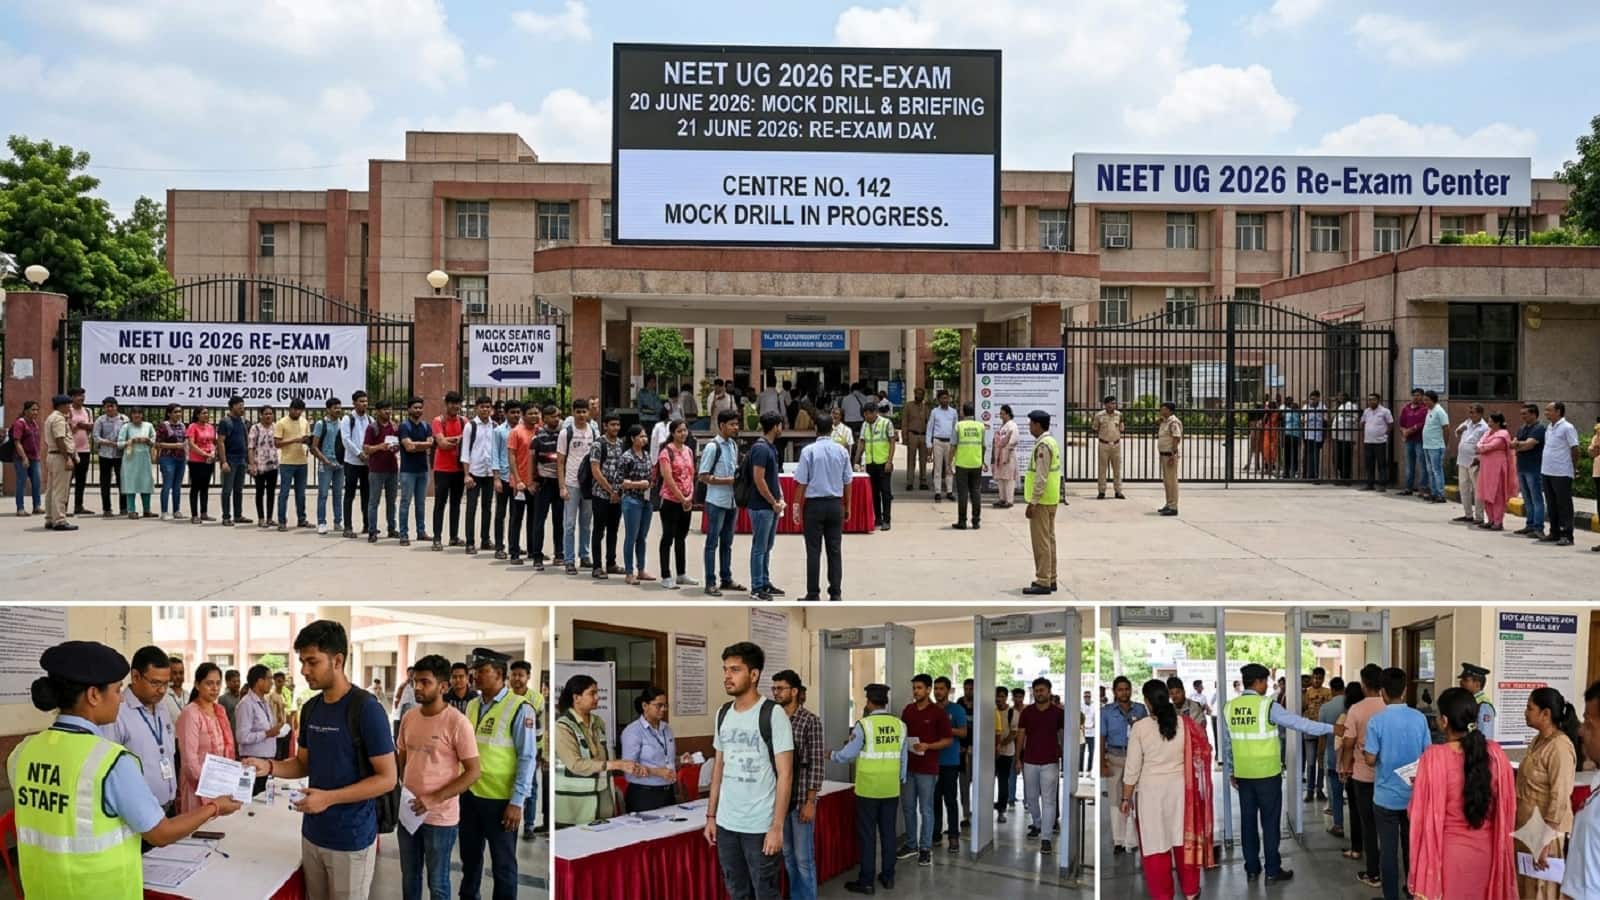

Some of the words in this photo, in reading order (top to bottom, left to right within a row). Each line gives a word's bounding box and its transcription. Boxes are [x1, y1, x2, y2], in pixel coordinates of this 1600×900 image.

[664, 62, 728, 85] NEET
[737, 63, 771, 86] UG
[779, 64, 833, 87] 2026
[841, 65, 951, 89] RE-EXAM
[630, 93, 650, 110] 20
[655, 93, 702, 111] JUNE
[709, 94, 755, 112] 2026:
[762, 95, 816, 113] MOCK
[822, 96, 874, 114] DRILL
[881, 97, 892, 115] &
[899, 97, 984, 116] BRIEFING
[677, 119, 697, 136] 21
[704, 120, 751, 137] JUNE
[757, 120, 803, 138] 2026:
[809, 121, 892, 139] RE-EXAM
[899, 122, 937, 139] DAY.
[723, 176, 807, 196] CENTRE
[814, 177, 849, 197] NO.
[857, 177, 891, 197] 142
[1097, 164, 1165, 192] NEET
[1174, 165, 1210, 192] UG
[1219, 165, 1286, 193] 2026
[1297, 167, 1412, 194] Re-Exam
[1423, 168, 1510, 195] Center
[665, 204, 727, 224] MOCK
[735, 205, 794, 225] DRILL
[800, 206, 819, 226] IN
[828, 207, 948, 227] PROGRESS.
[119, 331, 164, 348] NEET
[170, 331, 193, 349] UG
[200, 332, 243, 349] 2026
[250, 333, 331, 350] RE-EXAM
[476, 329, 506, 340] MOCK
[482, 342, 543, 352] ALLOCATION
[100, 353, 135, 365] MOCK
[140, 354, 174, 365] DRILL
[188, 354, 202, 366] 20
[242, 354, 272, 367] 2026
[276, 355, 348, 370] (SATURDAY)
[492, 355, 534, 365] DISPLAY
[140, 369, 209, 382] REPORTING
[214, 370, 247, 383] TIME:
[251, 371, 285, 383] 10:00
[289, 371, 308, 383] AM
[114, 385, 147, 397] EXAM
[151, 386, 175, 398] DAY
[188, 387, 202, 398] 21
[207, 387, 237, 399] JUNE
[242, 387, 272, 399] 2026
[276, 388, 334, 401] (SUNDAY)
[28, 762, 60, 786] NTA
[18, 786, 69, 813] STAFF
